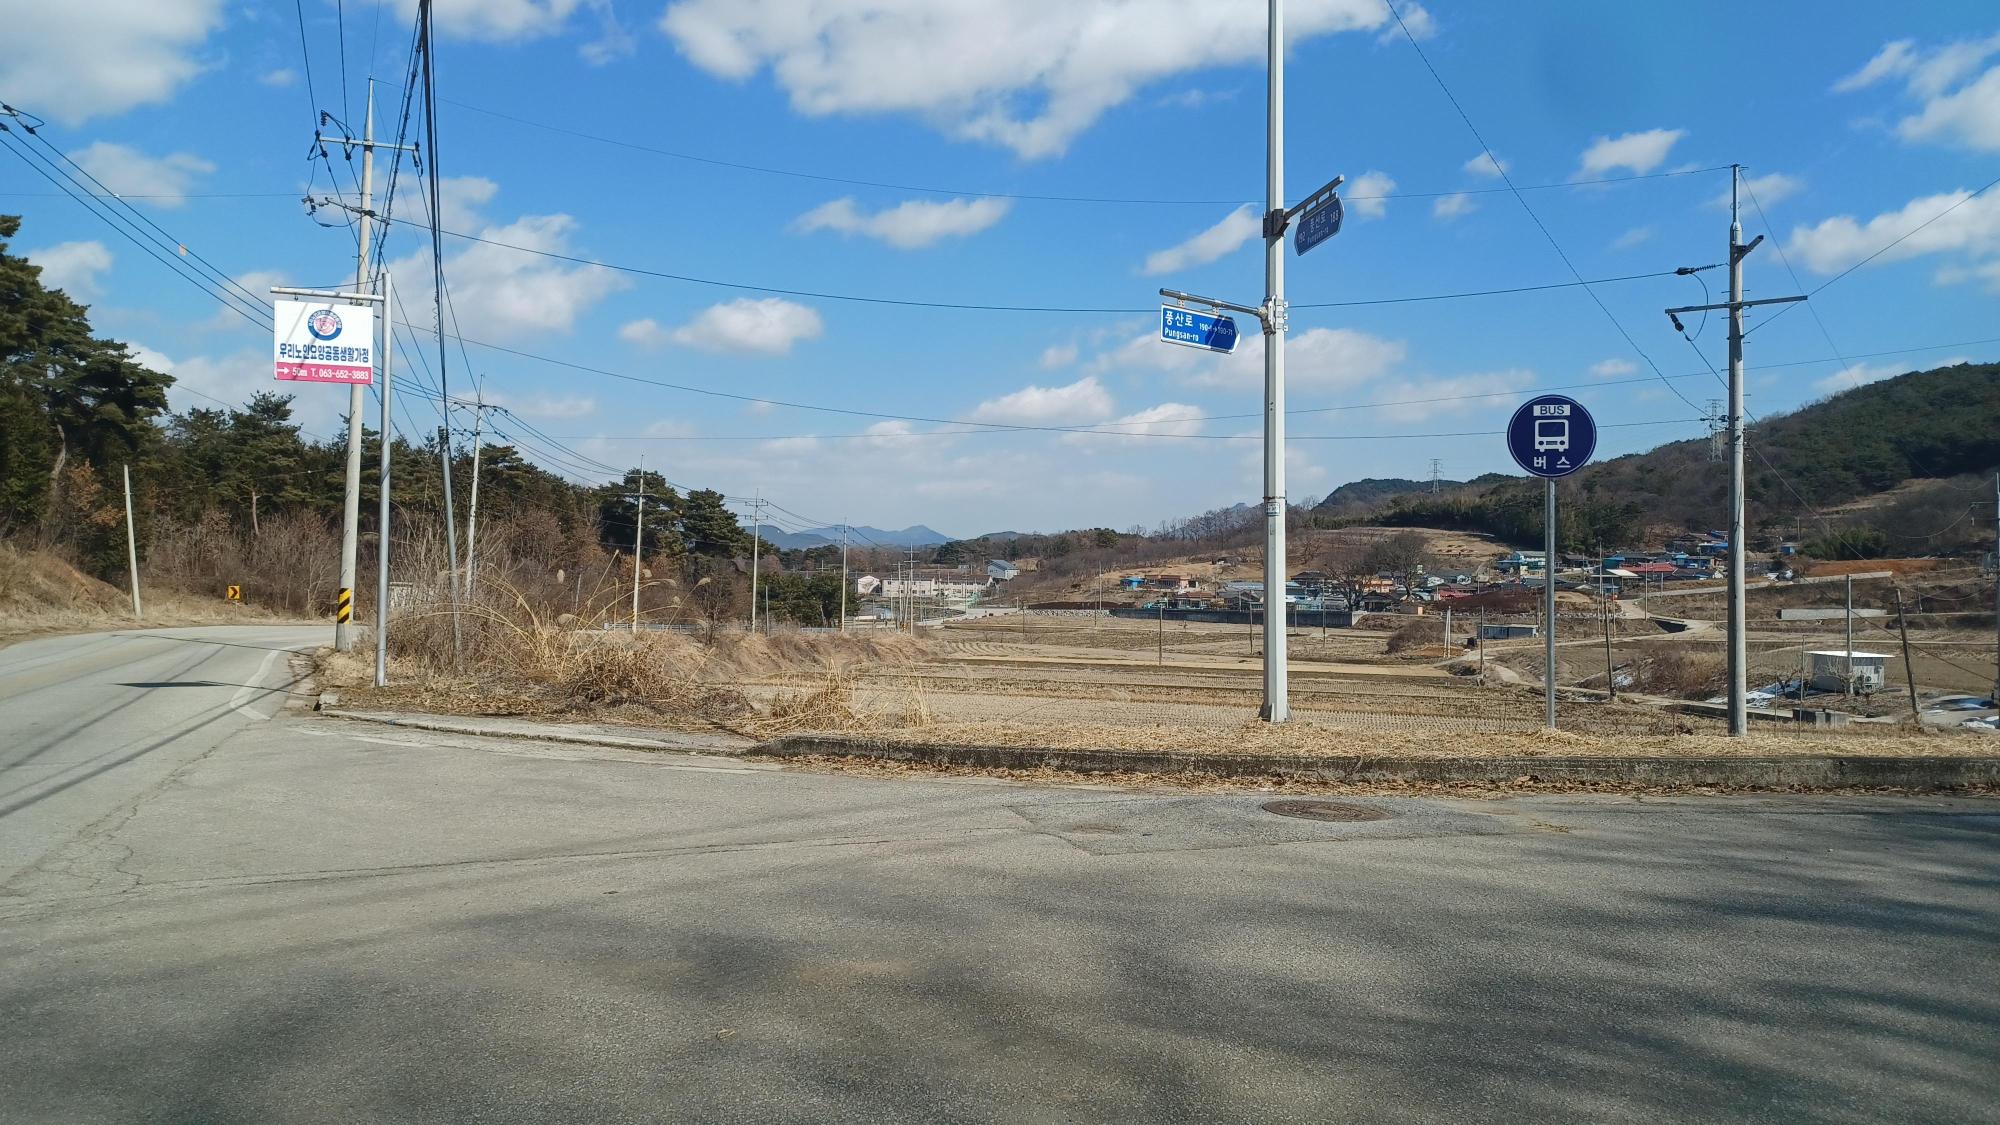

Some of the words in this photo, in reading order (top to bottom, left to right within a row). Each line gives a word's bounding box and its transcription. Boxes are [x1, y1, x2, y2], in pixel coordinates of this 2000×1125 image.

[1164, 310, 1194, 327] 풍산로
[1164, 327, 1199, 342] Pungsan-ro
[280, 342, 369, 363] 우리노인요양공동생활가정
[1540, 405, 1565, 415] BUS
